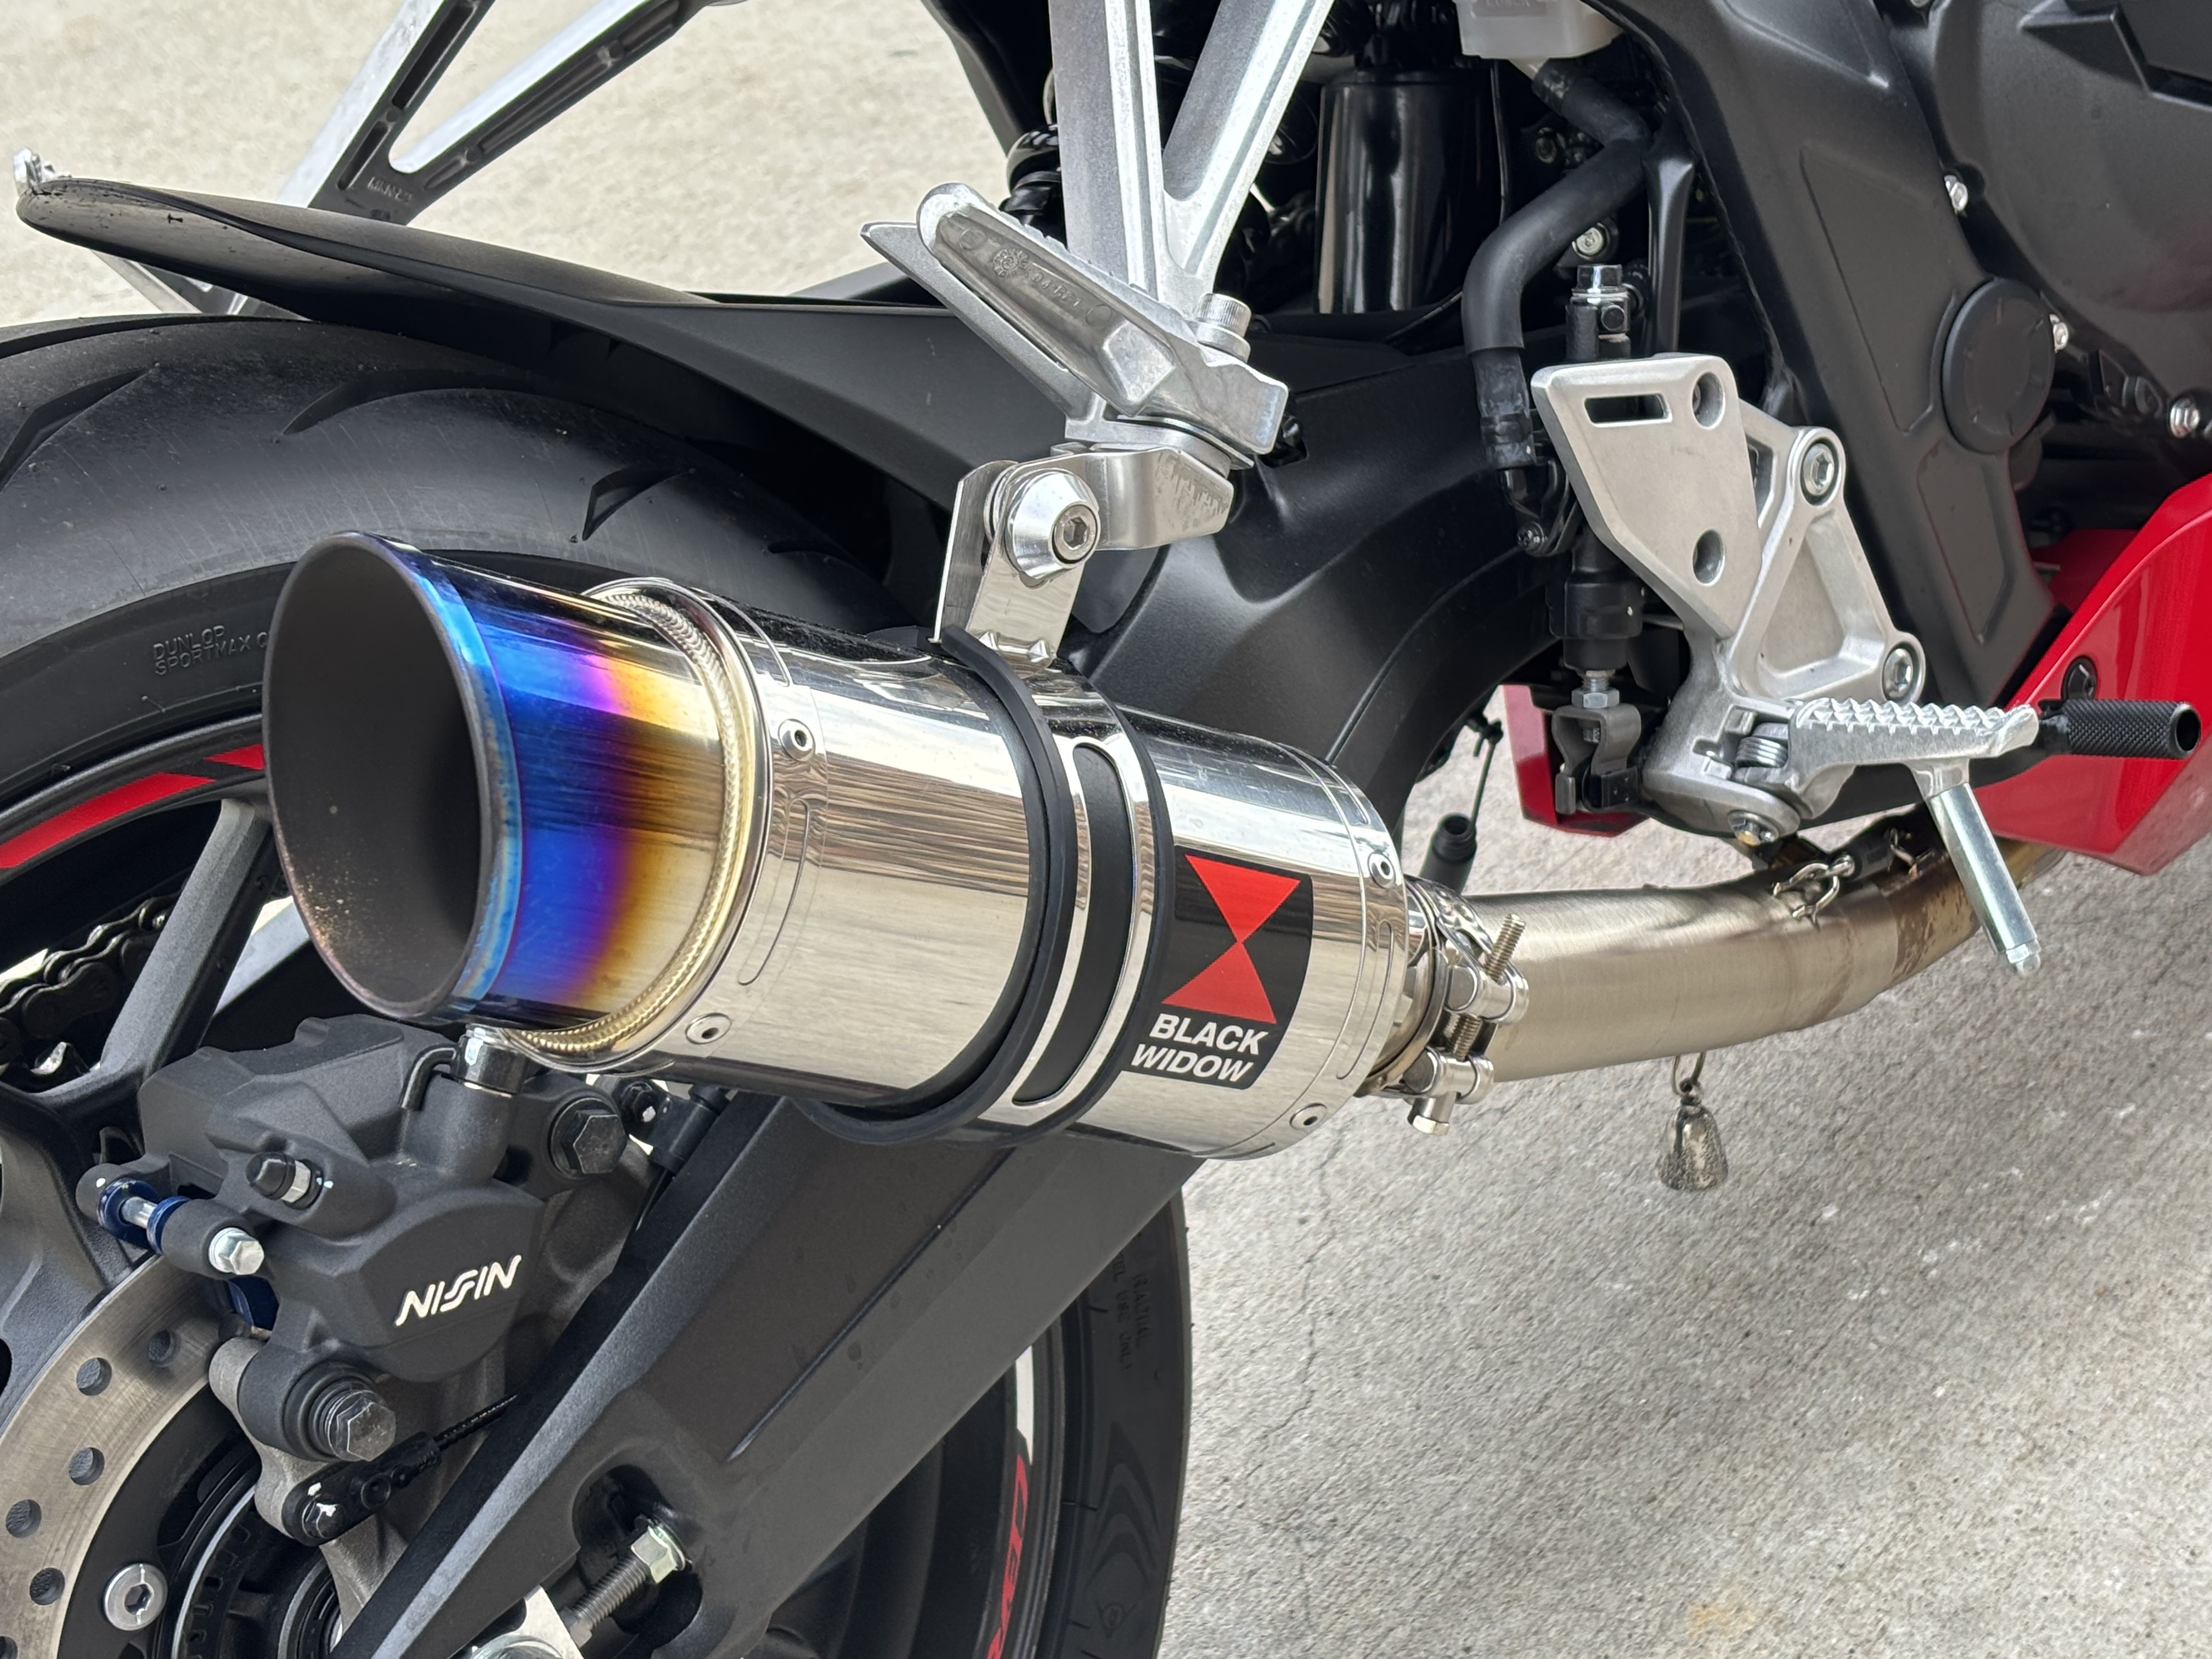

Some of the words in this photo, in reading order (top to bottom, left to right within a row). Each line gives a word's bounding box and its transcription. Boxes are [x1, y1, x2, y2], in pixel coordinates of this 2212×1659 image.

[153, 625, 225, 660] DUNLOP
[155, 635, 251, 675] SPORTMAX
[1149, 1013, 1268, 1056] BLACK
[1131, 1043, 1254, 1083] WIDOW
[394, 1254, 522, 1327] NISSIN
